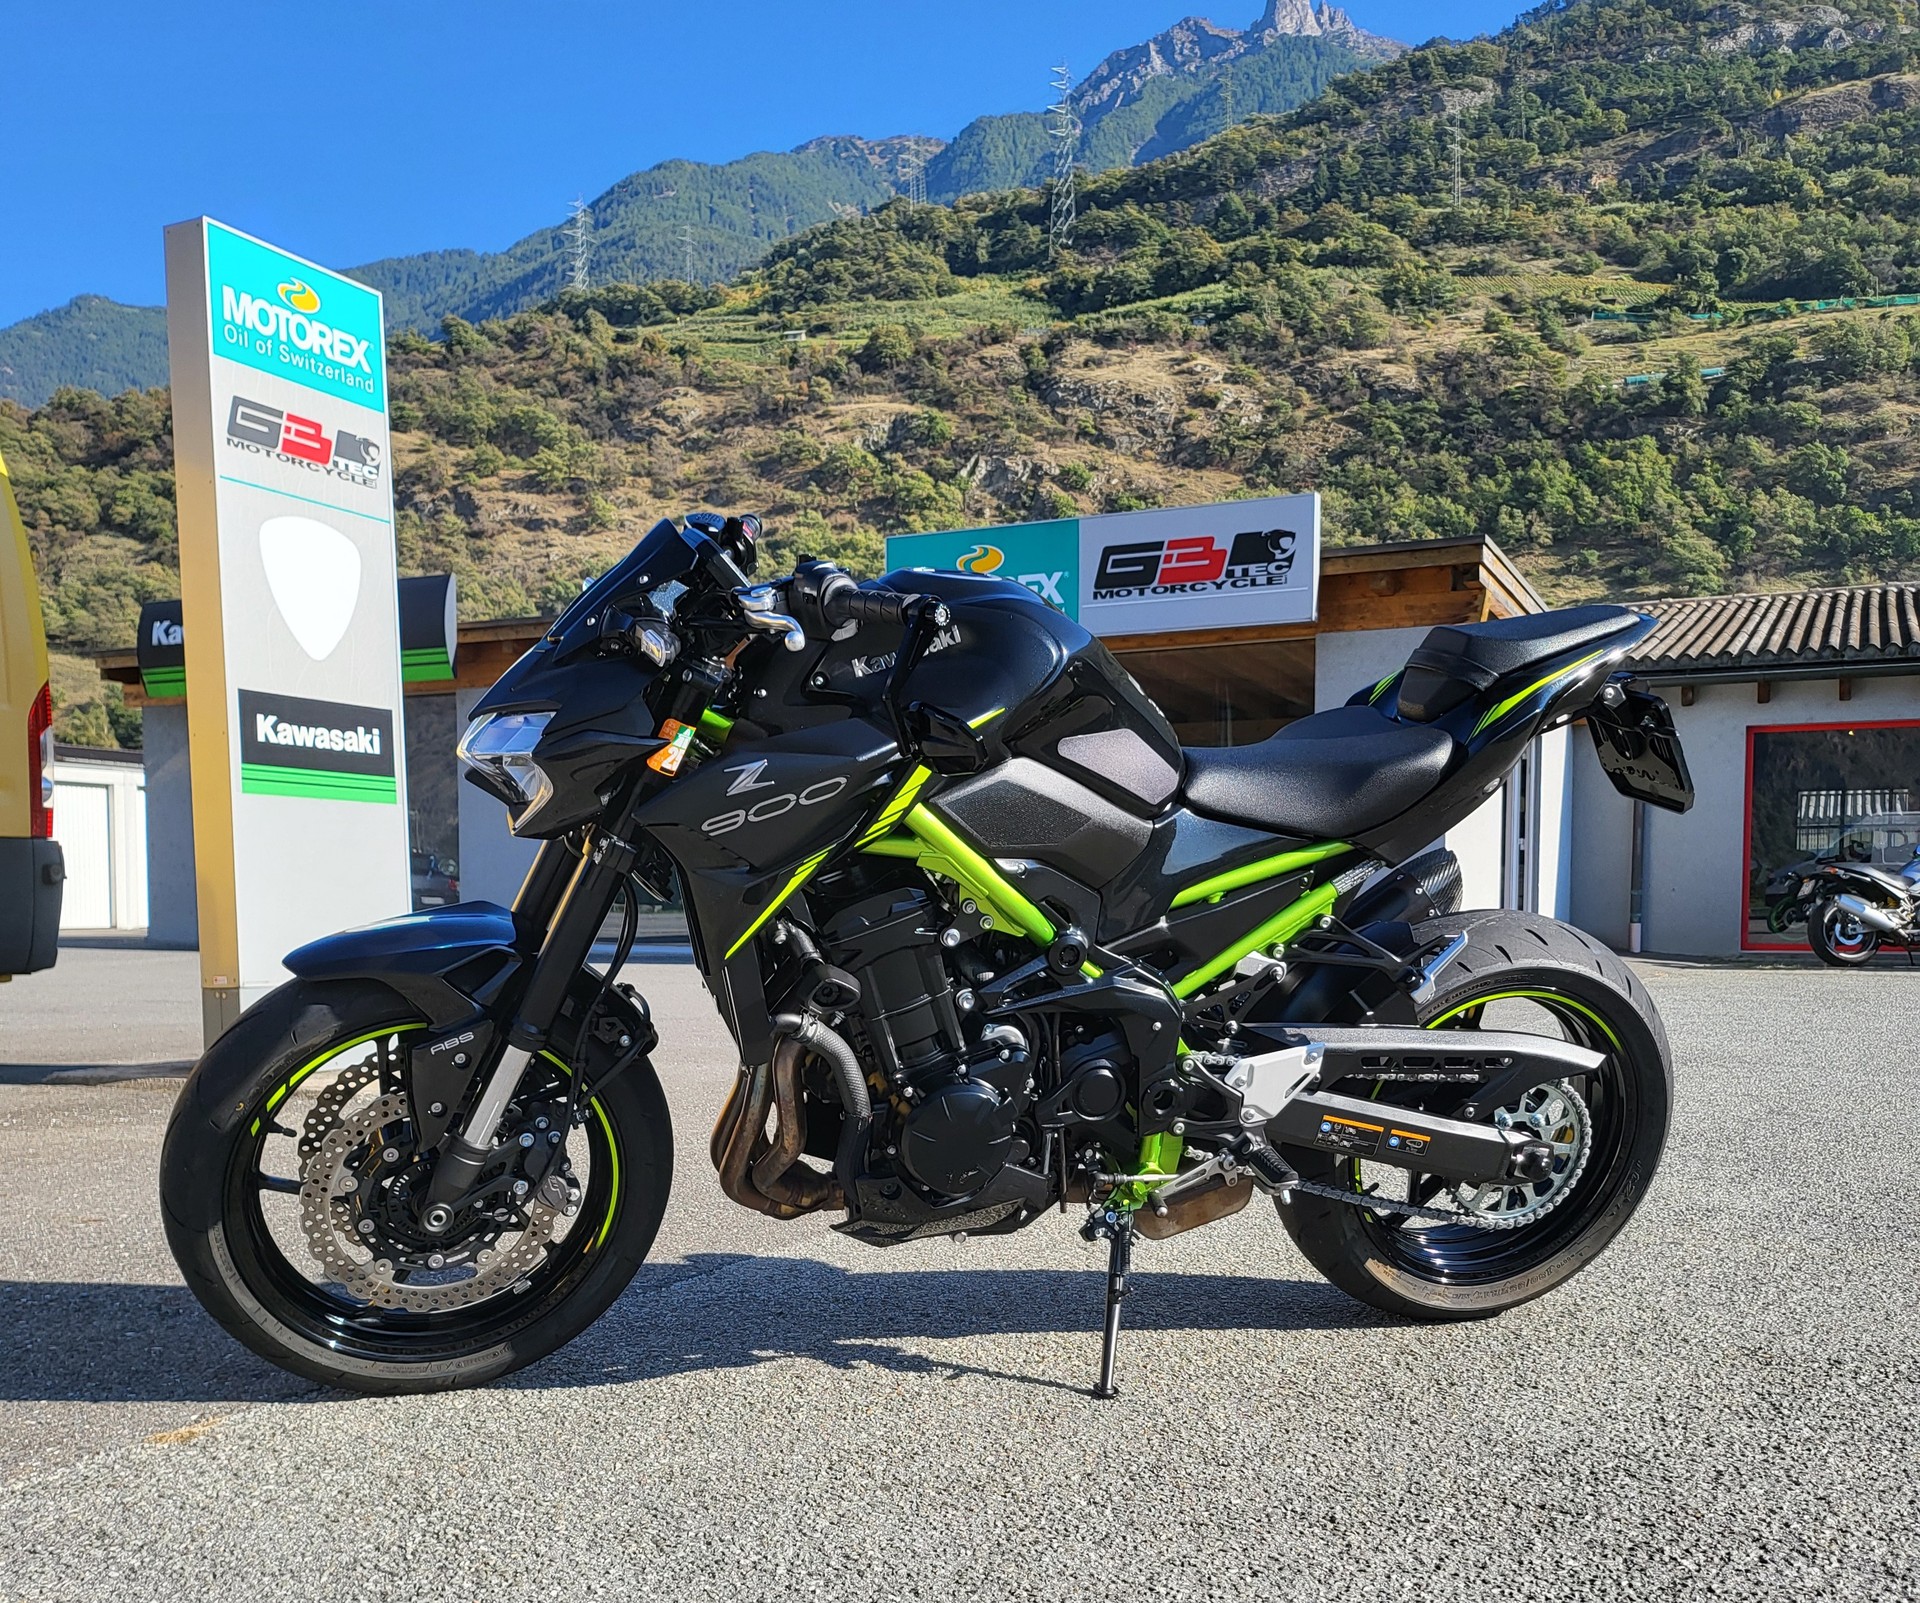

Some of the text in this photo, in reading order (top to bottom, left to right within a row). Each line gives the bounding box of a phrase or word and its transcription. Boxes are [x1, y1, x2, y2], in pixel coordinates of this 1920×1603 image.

[222, 284, 373, 375] MOTOREX
[223, 323, 375, 394] Oil of Switzerland
[226, 437, 378, 490] MOTORCYCLE
[333, 455, 380, 481] TEC
[1092, 575, 1284, 601] MOTORCYCLE
[1227, 561, 1291, 579] TEC
[255, 713, 382, 756] Kawasaki
[723, 758, 776, 797] Z
[700, 774, 850, 838] 900
[430, 1031, 475, 1056] ABS
